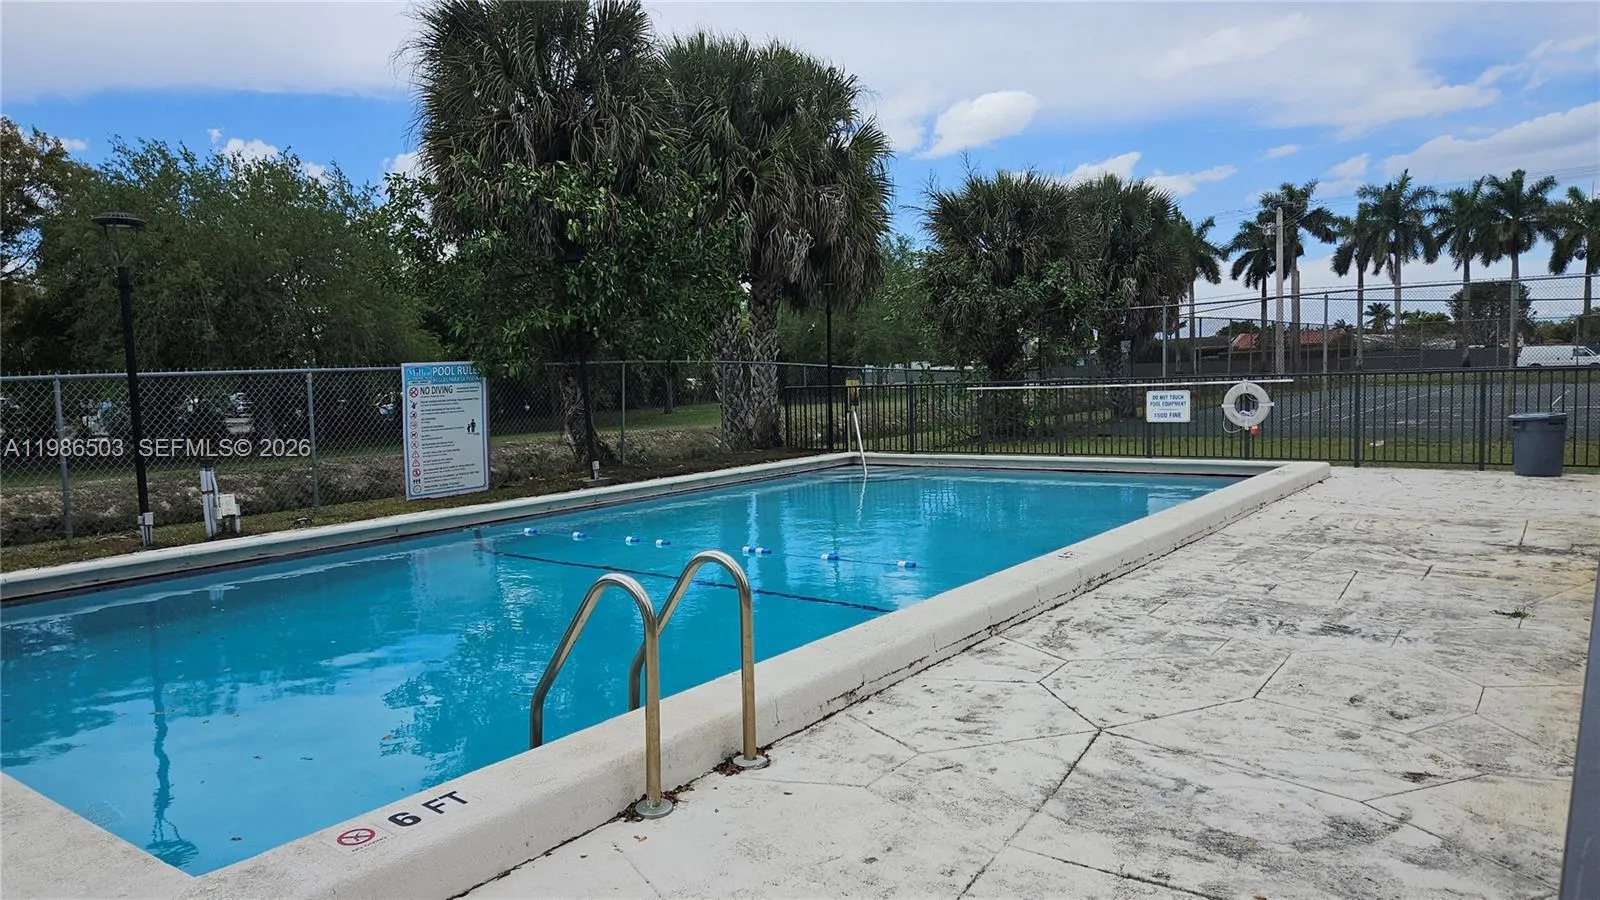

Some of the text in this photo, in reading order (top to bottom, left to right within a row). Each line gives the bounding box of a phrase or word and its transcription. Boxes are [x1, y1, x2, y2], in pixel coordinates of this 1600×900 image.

[432, 366, 455, 376] POOL
[420, 386, 430, 395] NO
[431, 385, 454, 394] DIVING
[387, 790, 469, 827] 6 FT
